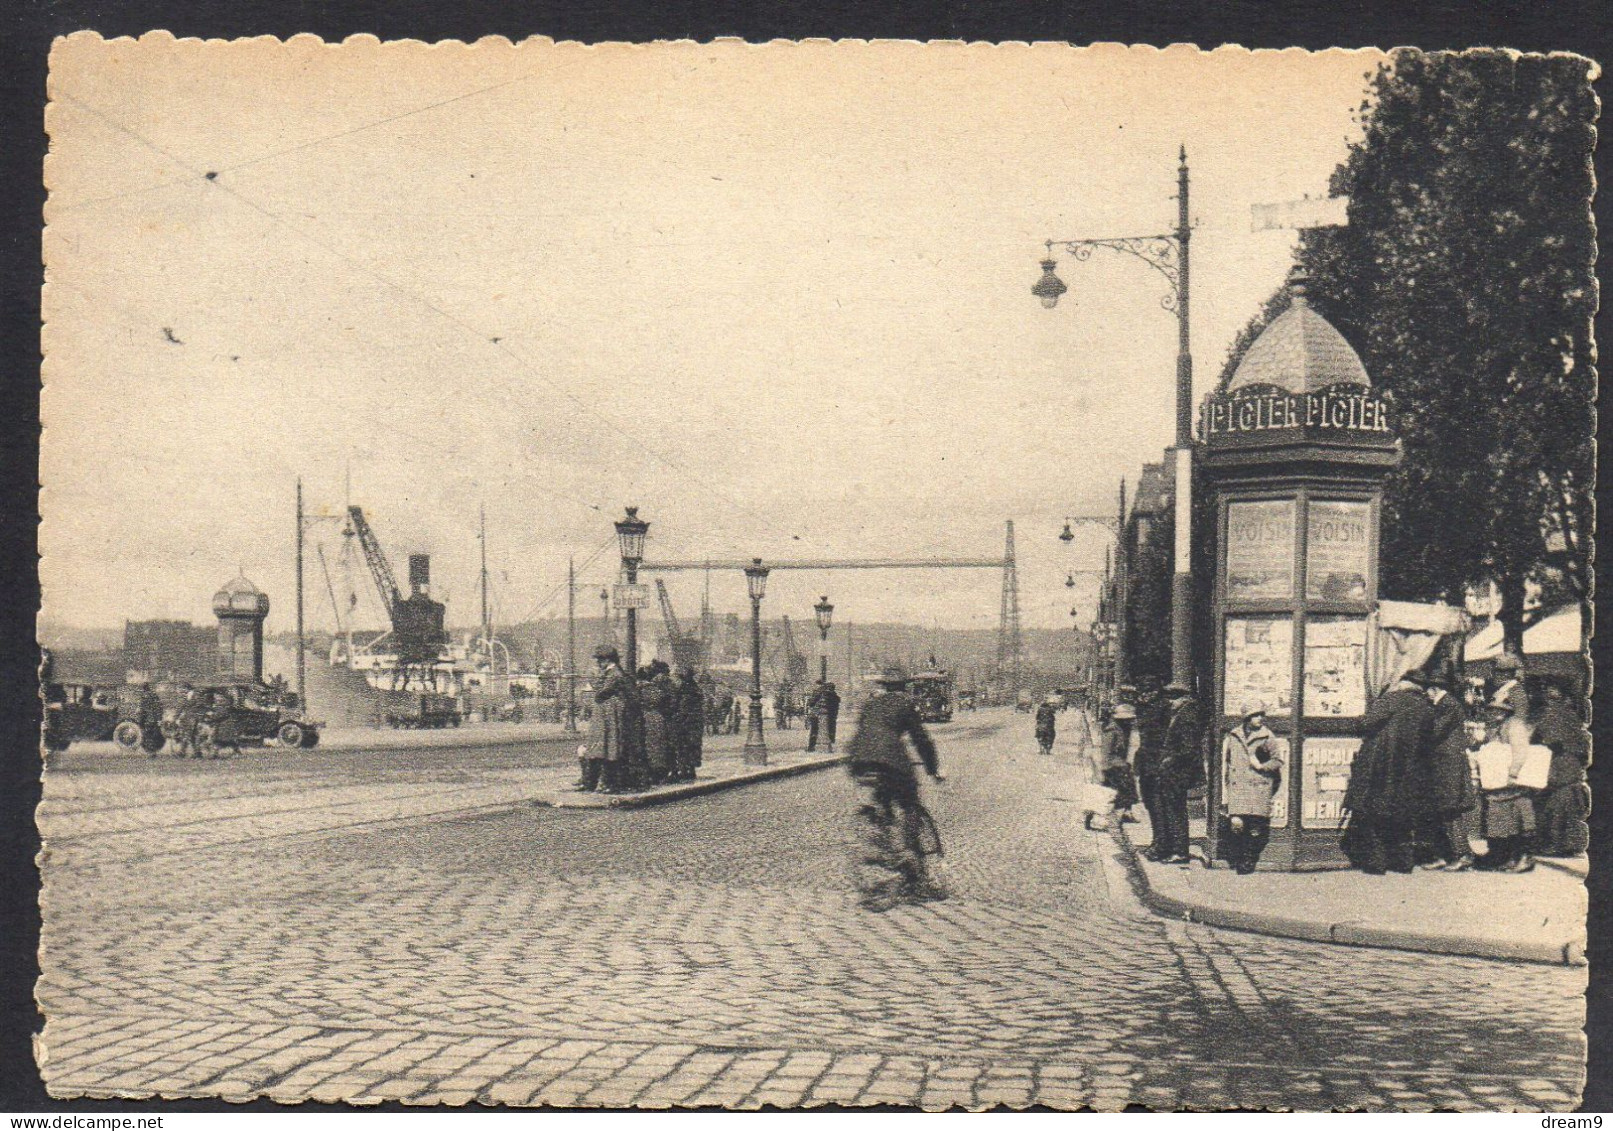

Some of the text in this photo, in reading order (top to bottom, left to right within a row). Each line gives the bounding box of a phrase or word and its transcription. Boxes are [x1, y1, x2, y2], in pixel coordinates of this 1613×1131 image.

[1209, 397, 1300, 433] PIGIER
[1305, 394, 1391, 432] PIGIER
[1312, 521, 1366, 542] VOISIN
